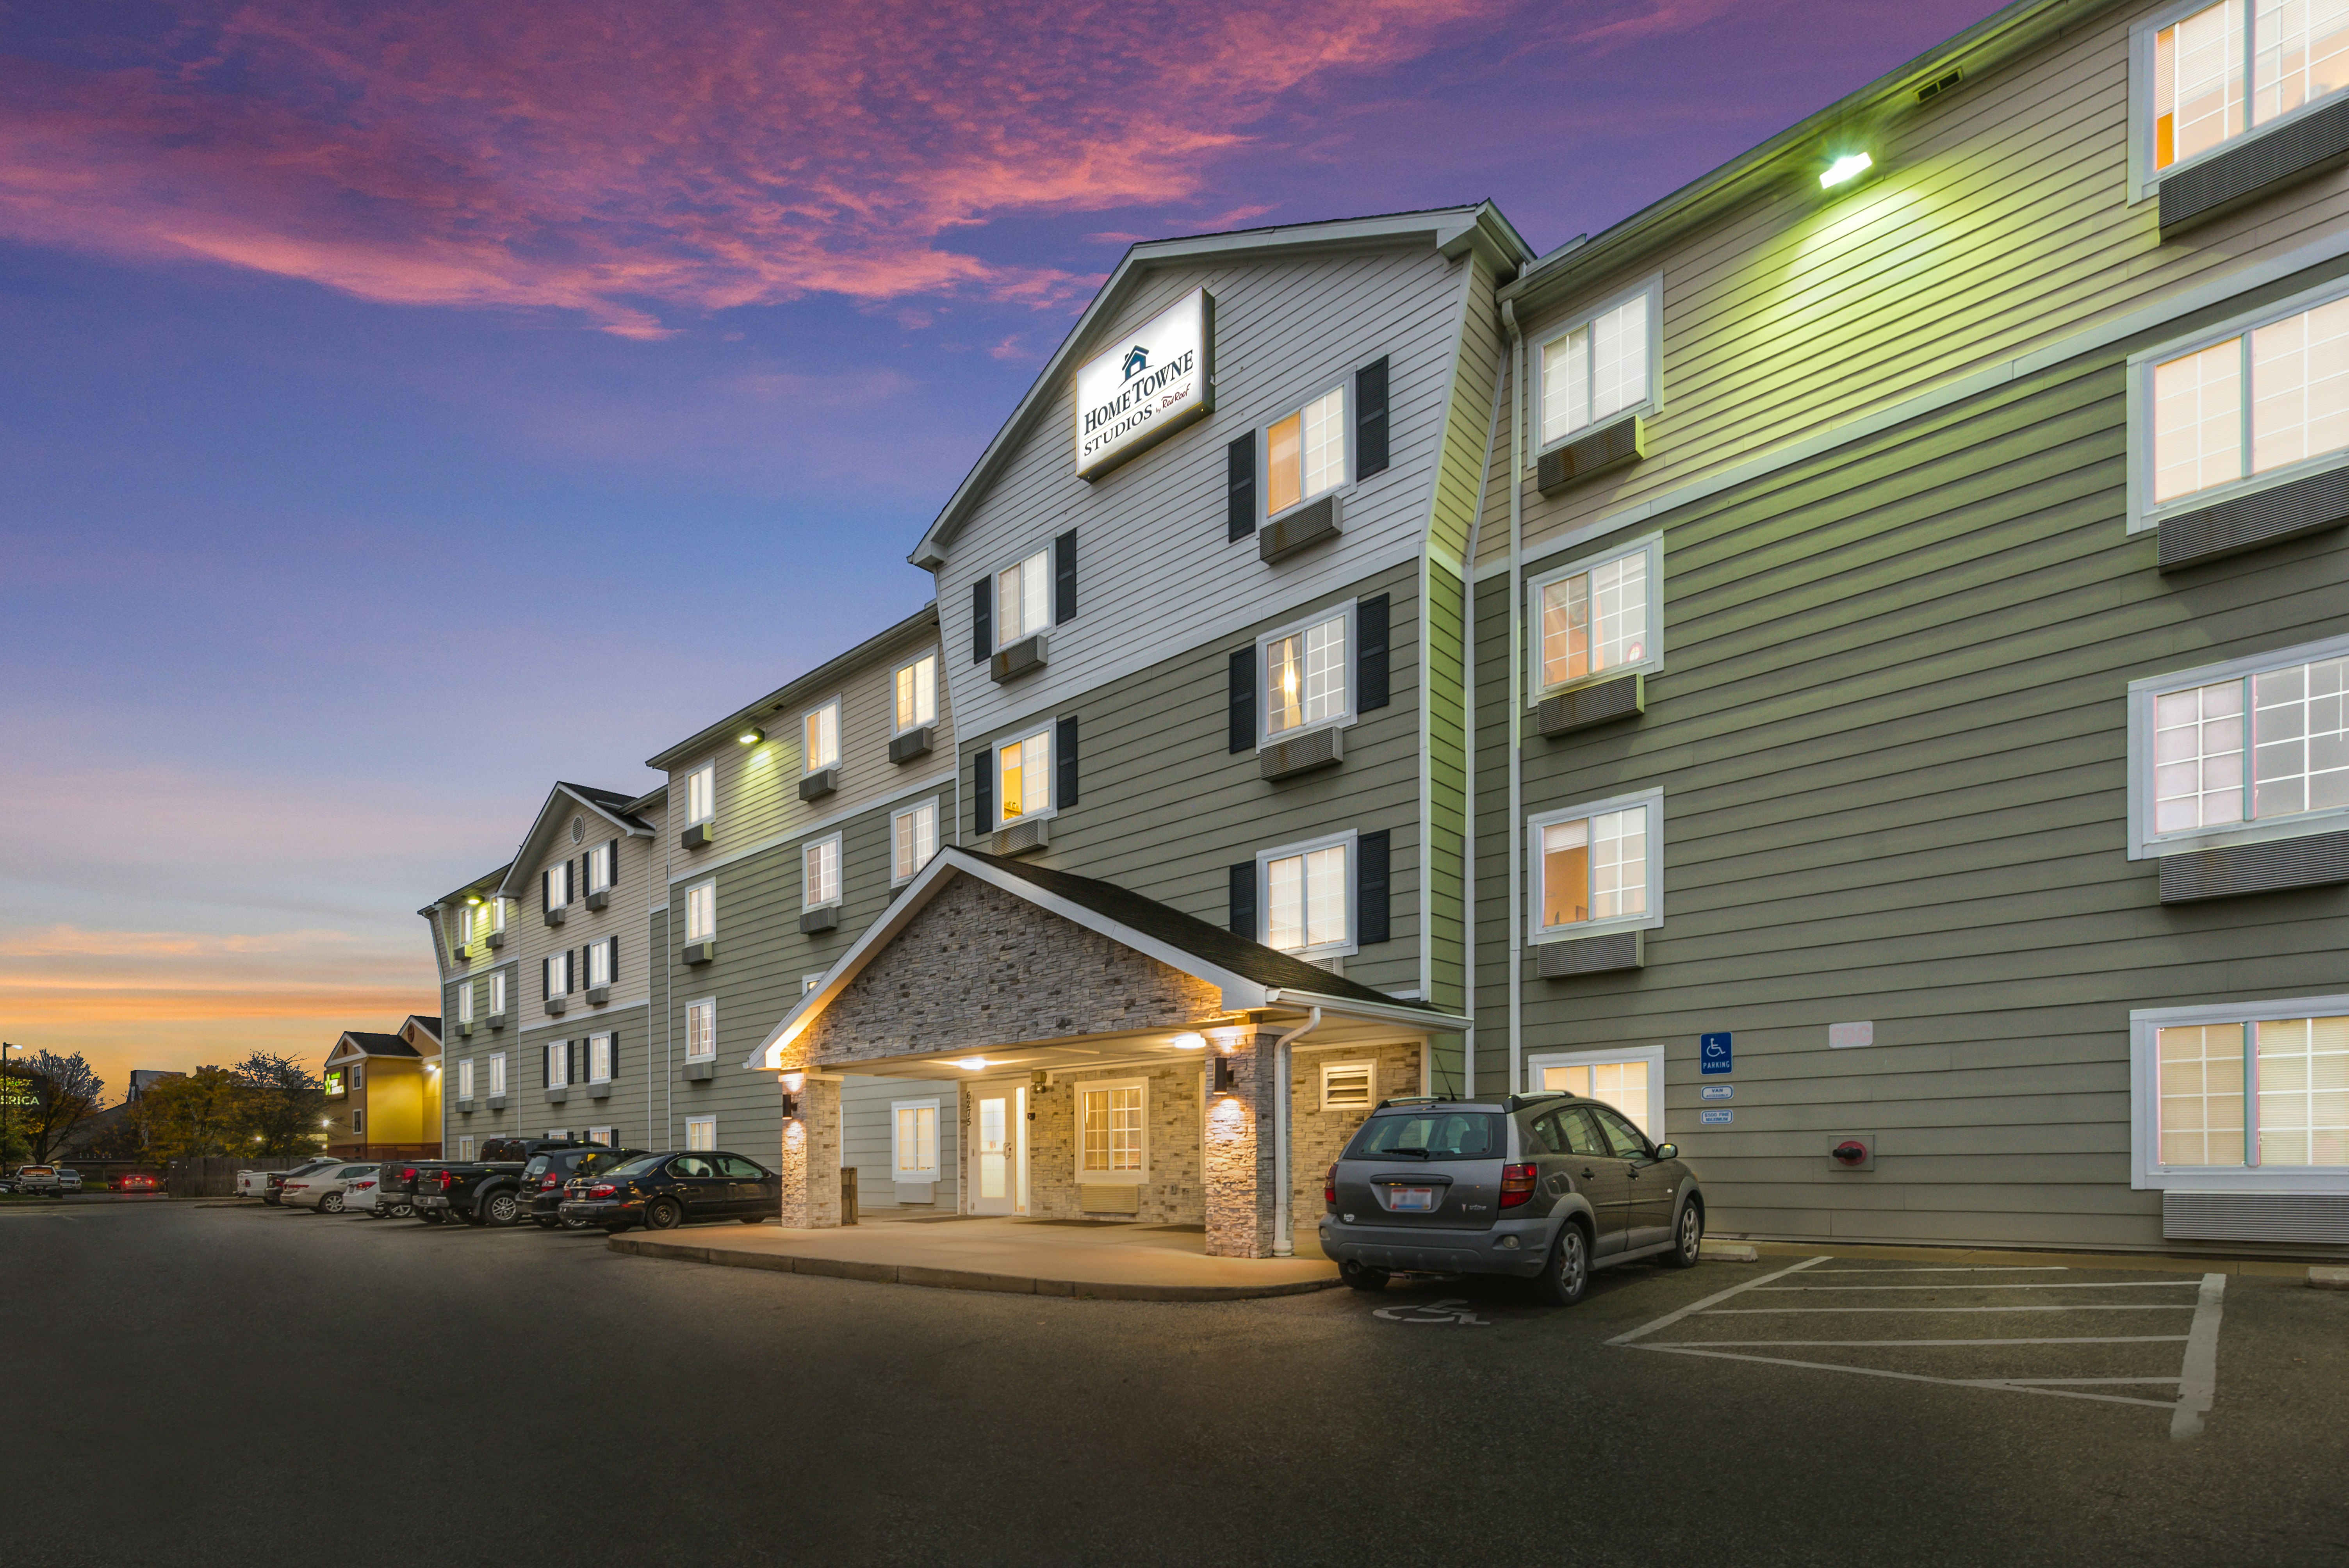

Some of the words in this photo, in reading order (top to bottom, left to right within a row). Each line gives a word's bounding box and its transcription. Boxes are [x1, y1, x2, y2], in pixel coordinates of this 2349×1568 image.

[1084, 404, 1152, 457] STUDIOS
[1831, 1025, 1871, 1044] FDC
[1703, 1061, 1730, 1069] PARKING
